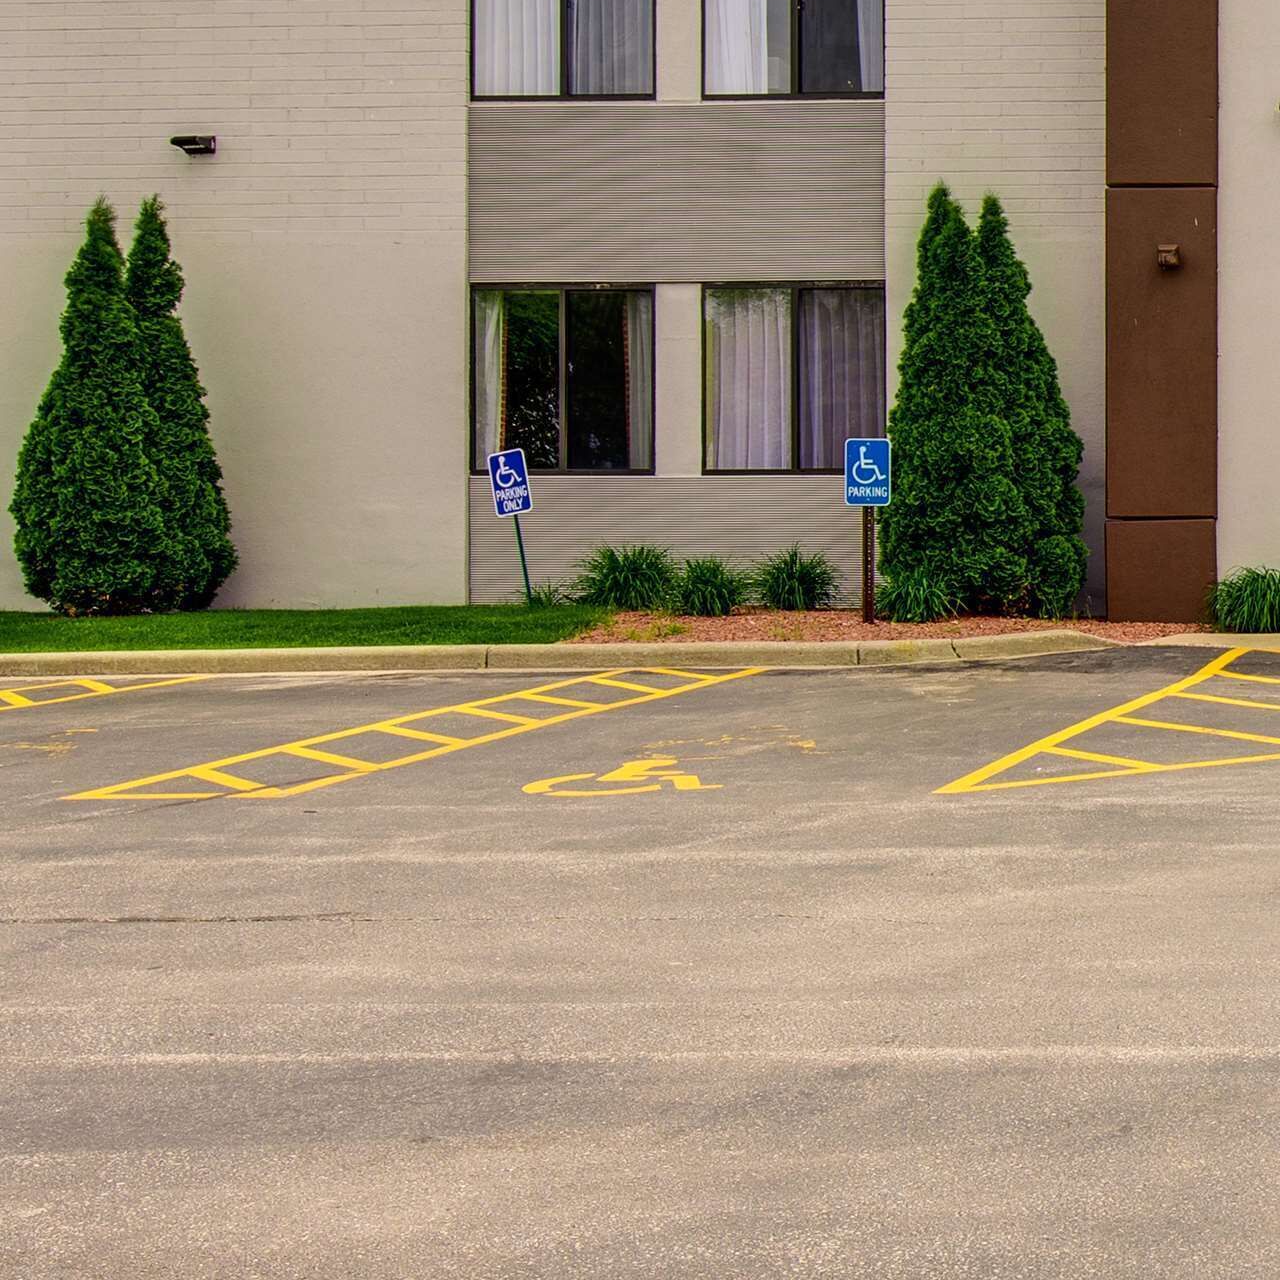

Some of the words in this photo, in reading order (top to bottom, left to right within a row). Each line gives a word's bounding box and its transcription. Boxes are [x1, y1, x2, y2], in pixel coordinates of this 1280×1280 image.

[495, 484, 528, 502] PARKING
[848, 486, 888, 498] PARKING
[503, 497, 523, 513] ONLY
